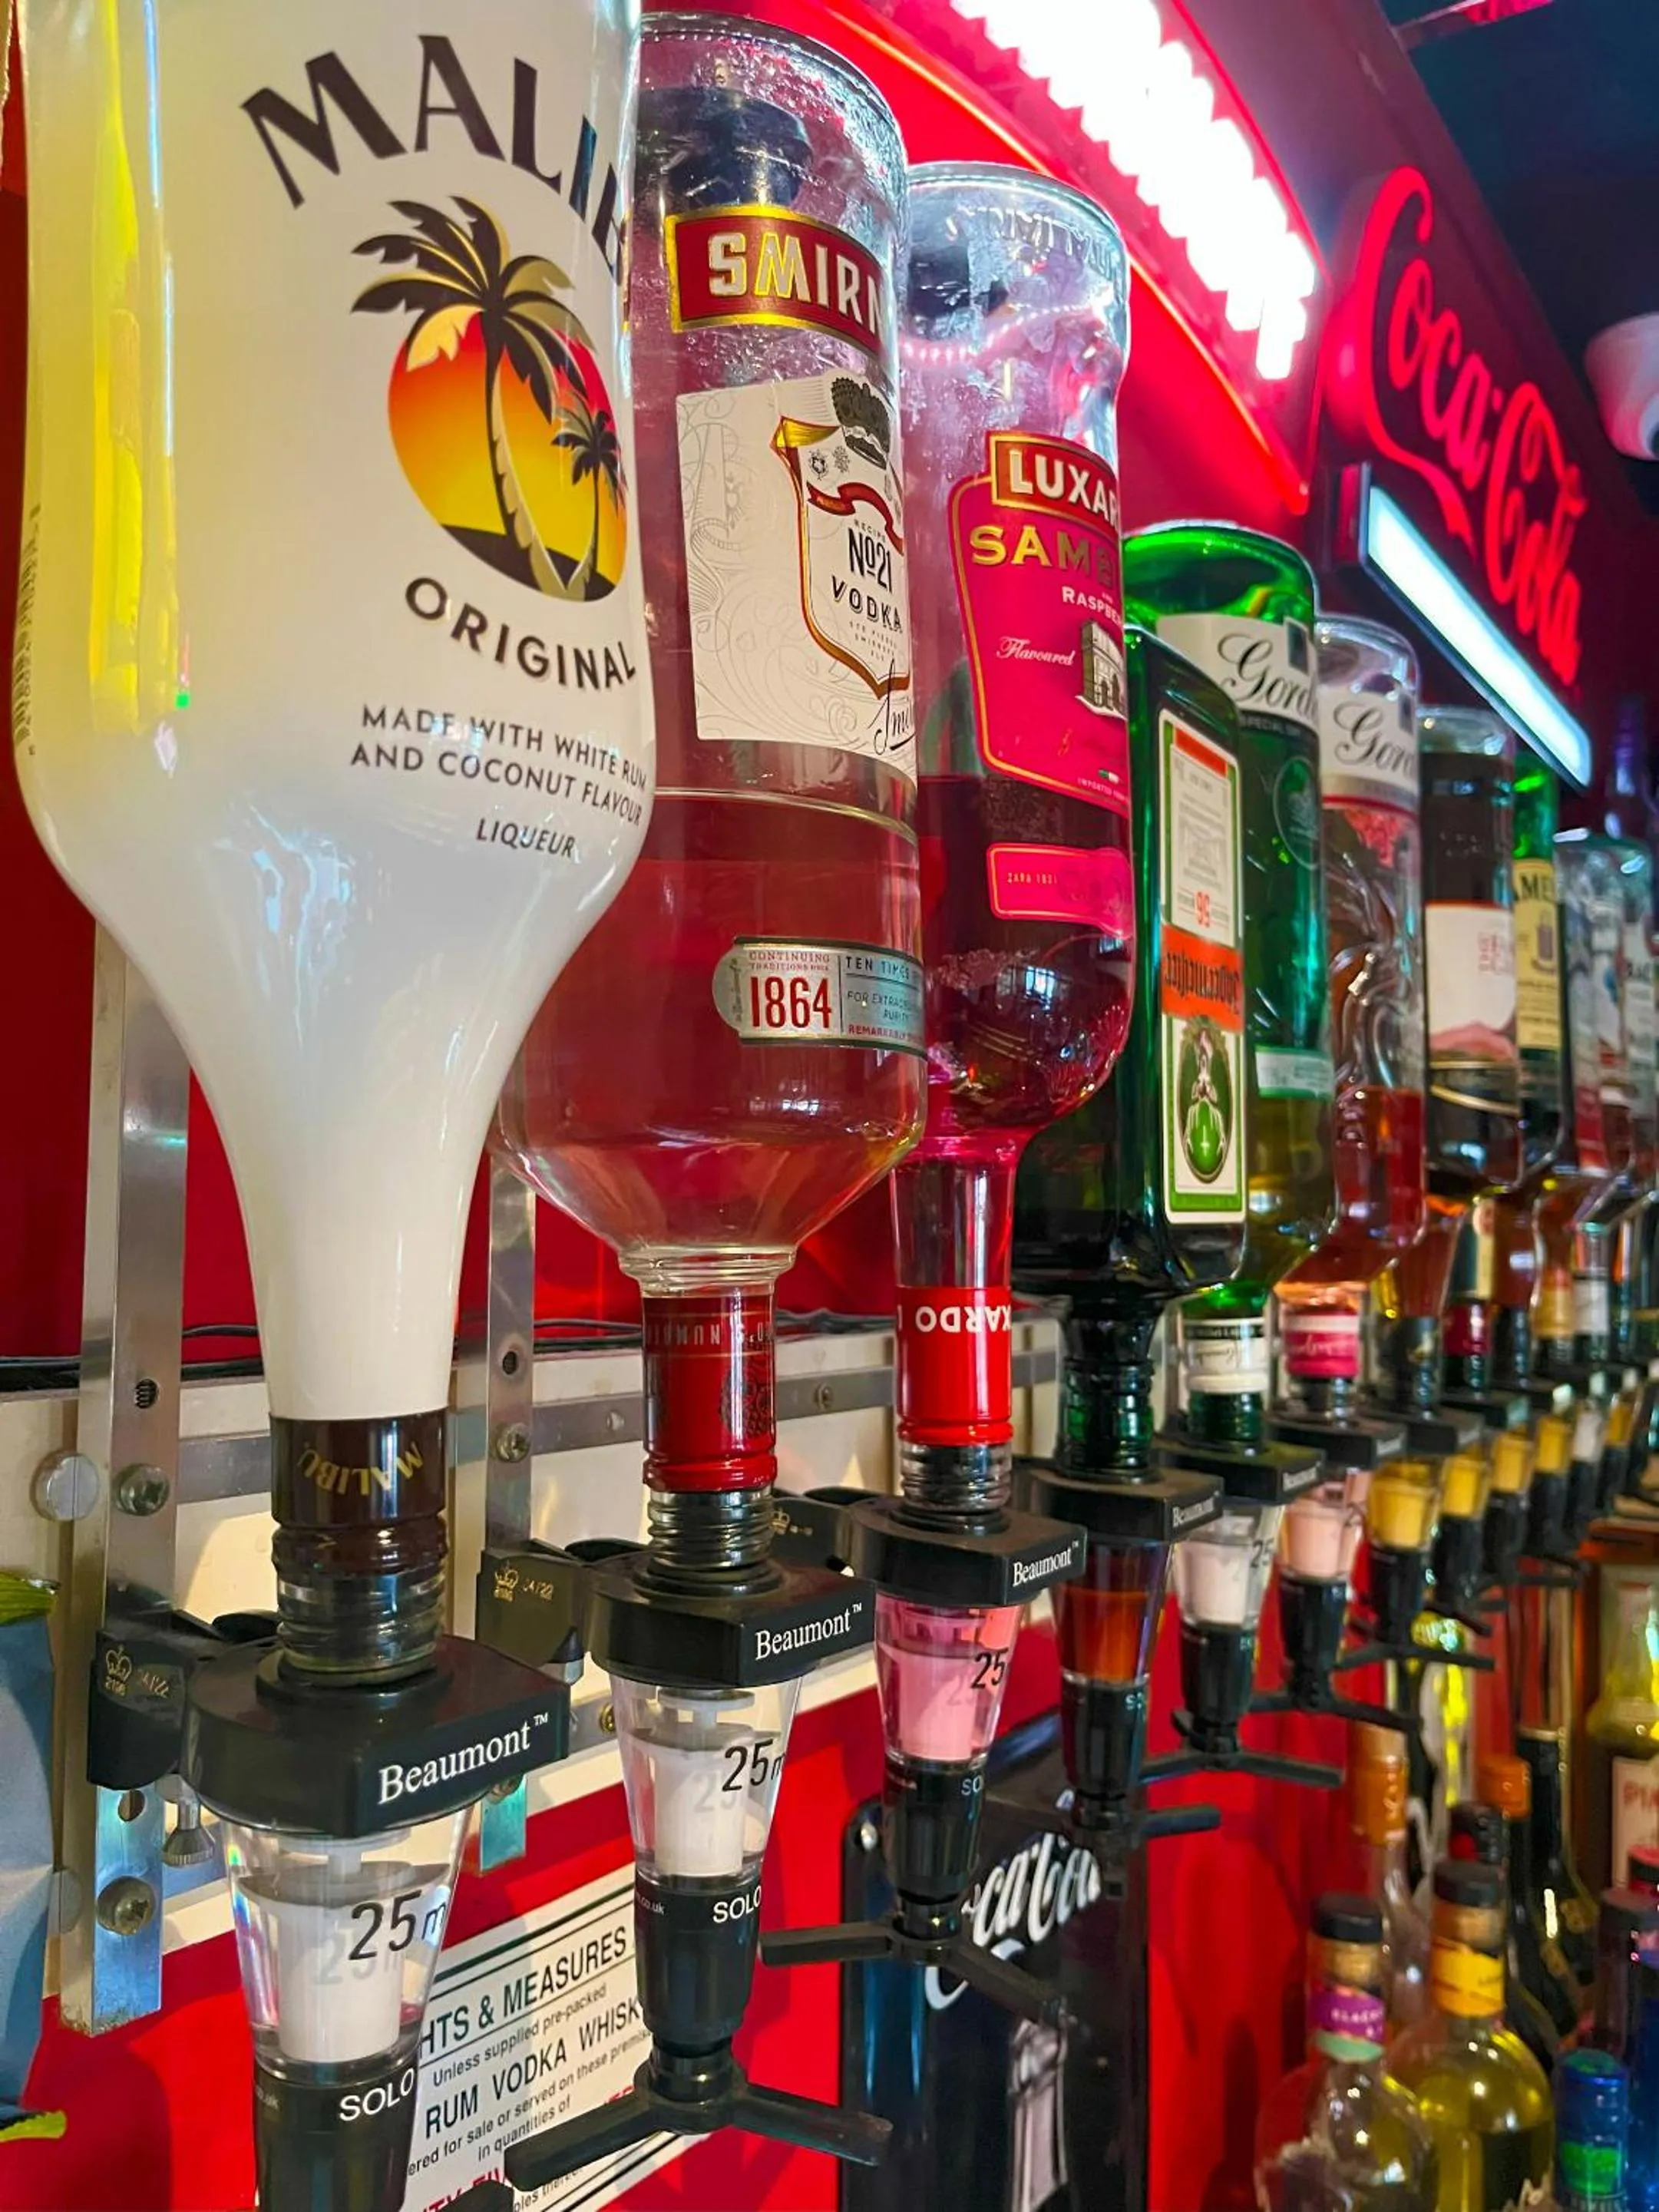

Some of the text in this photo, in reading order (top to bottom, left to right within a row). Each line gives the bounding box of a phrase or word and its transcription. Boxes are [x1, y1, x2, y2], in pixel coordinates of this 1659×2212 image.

[832, 575, 903, 633] VODKA
[405, 577, 636, 689] ORIGINAL
[996, 636, 1076, 666] Flavoured
[362, 704, 456, 736] MADE
[471, 717, 543, 752] WITH
[554, 735, 616, 775] WHITE
[351, 742, 424, 771] AND
[438, 751, 575, 798] COCONUT
[476, 818, 576, 858] LIQUEUR
[749, 951, 830, 963] CONTINUING
[846, 956, 873, 971] TEN
[750, 975, 832, 1029] 1864
[848, 990, 869, 1004] FOR
[297, 1441, 425, 1496] MALIBU
[1012, 1548, 1072, 1588] Beaumont
[755, 1609, 852, 1661] Beaumont
[378, 1721, 531, 1805] Beaumont
[478, 1996, 494, 2029] &
[504, 1926, 626, 2019] MEASURES
[433, 1985, 606, 2087] Unless supplied pre-packed
[339, 2067, 415, 2121] SOLO
[425, 2084, 479, 2140] RUM
[492, 2038, 567, 2102] VODKA
[444, 2135, 463, 2159] for
[467, 2119, 494, 2144] sale
[497, 2110, 512, 2128] or
[515, 2085, 556, 2118] served
[559, 2074, 575, 2091] on
[577, 2053, 608, 2081] these
[478, 2096, 572, 2162] in quantities of
